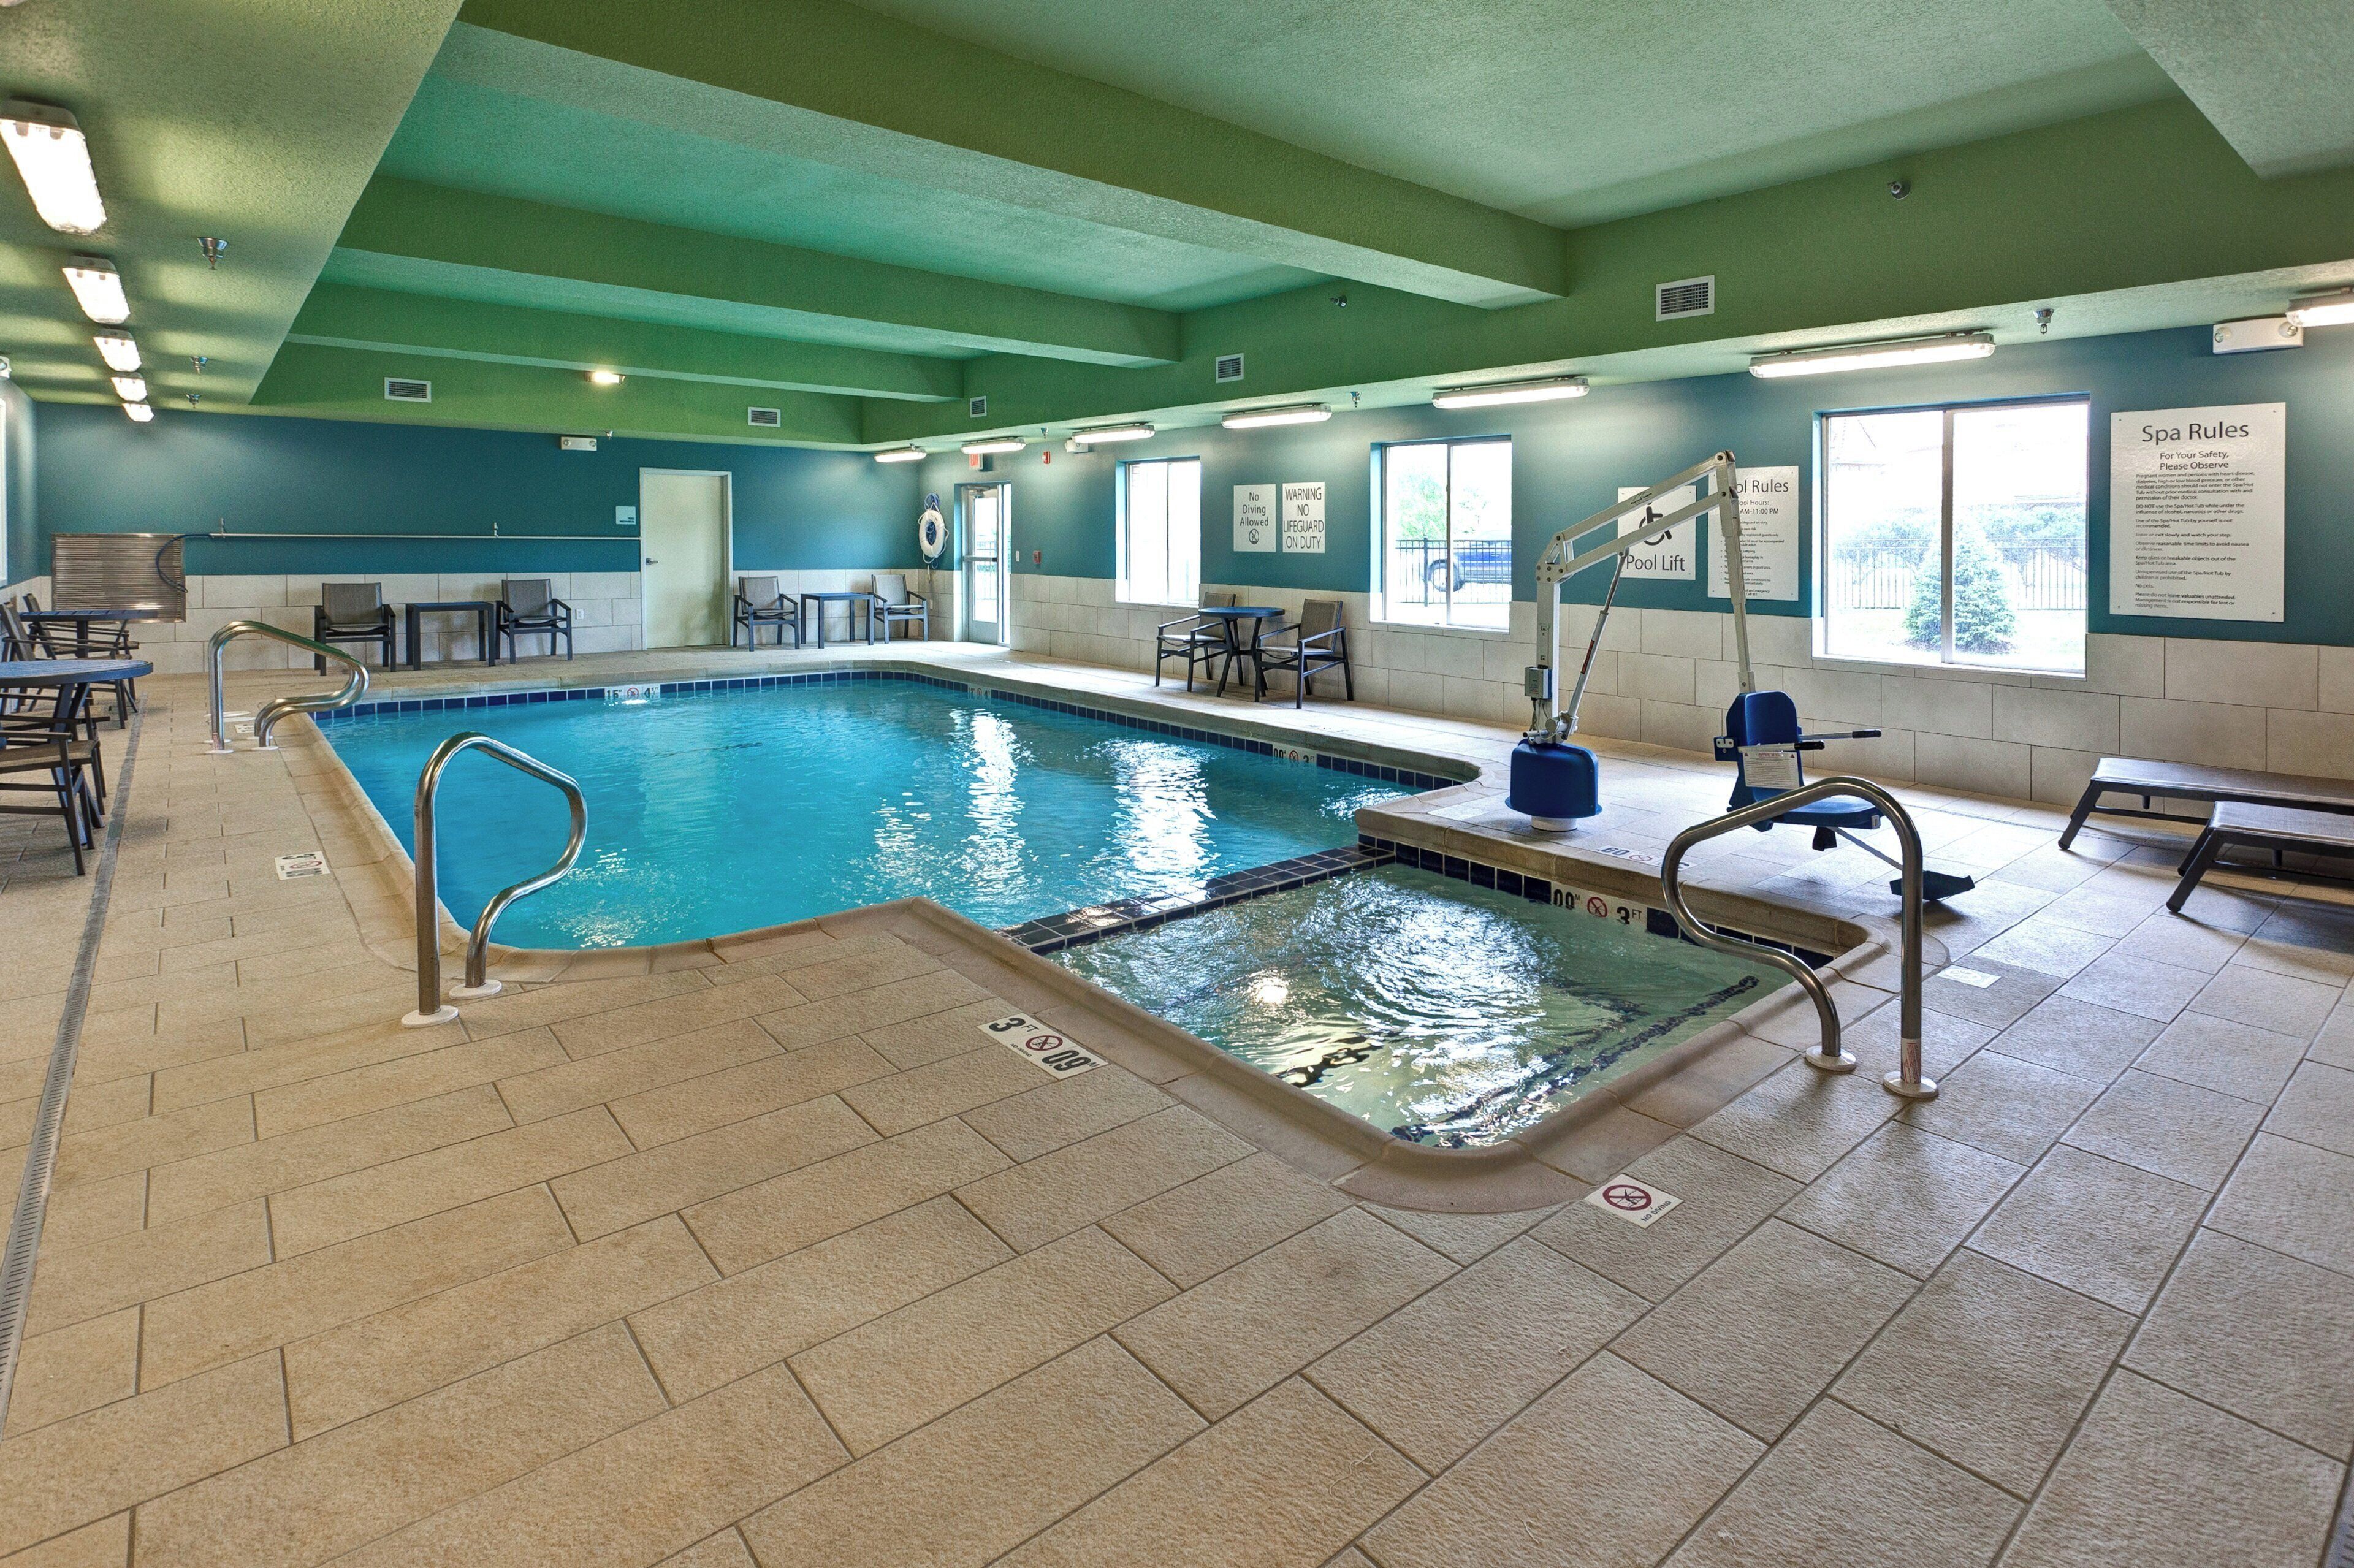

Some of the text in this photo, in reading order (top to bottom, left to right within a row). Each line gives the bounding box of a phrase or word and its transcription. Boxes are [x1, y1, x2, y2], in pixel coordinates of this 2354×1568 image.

[2142, 421, 2249, 446] Spa Rules
[2199, 451, 2229, 460] Safety,
[1753, 479, 1788, 493] Rules
[1249, 492, 1259, 501] No
[1286, 487, 1322, 501] WARNING
[1243, 504, 1266, 516] Diving
[1297, 504, 1309, 516] NO
[1240, 517, 1269, 526] Allowed
[1284, 520, 1324, 533] LIFEGUARD
[1286, 536, 1321, 549] ON DUTY
[1626, 554, 1685, 571] Pool Lift
[1632, 909, 1642, 919] FT
[989, 1018, 1026, 1032] 3
[1017, 1046, 1032, 1057] DIVING
[1650, 1200, 1672, 1215] DIVING
